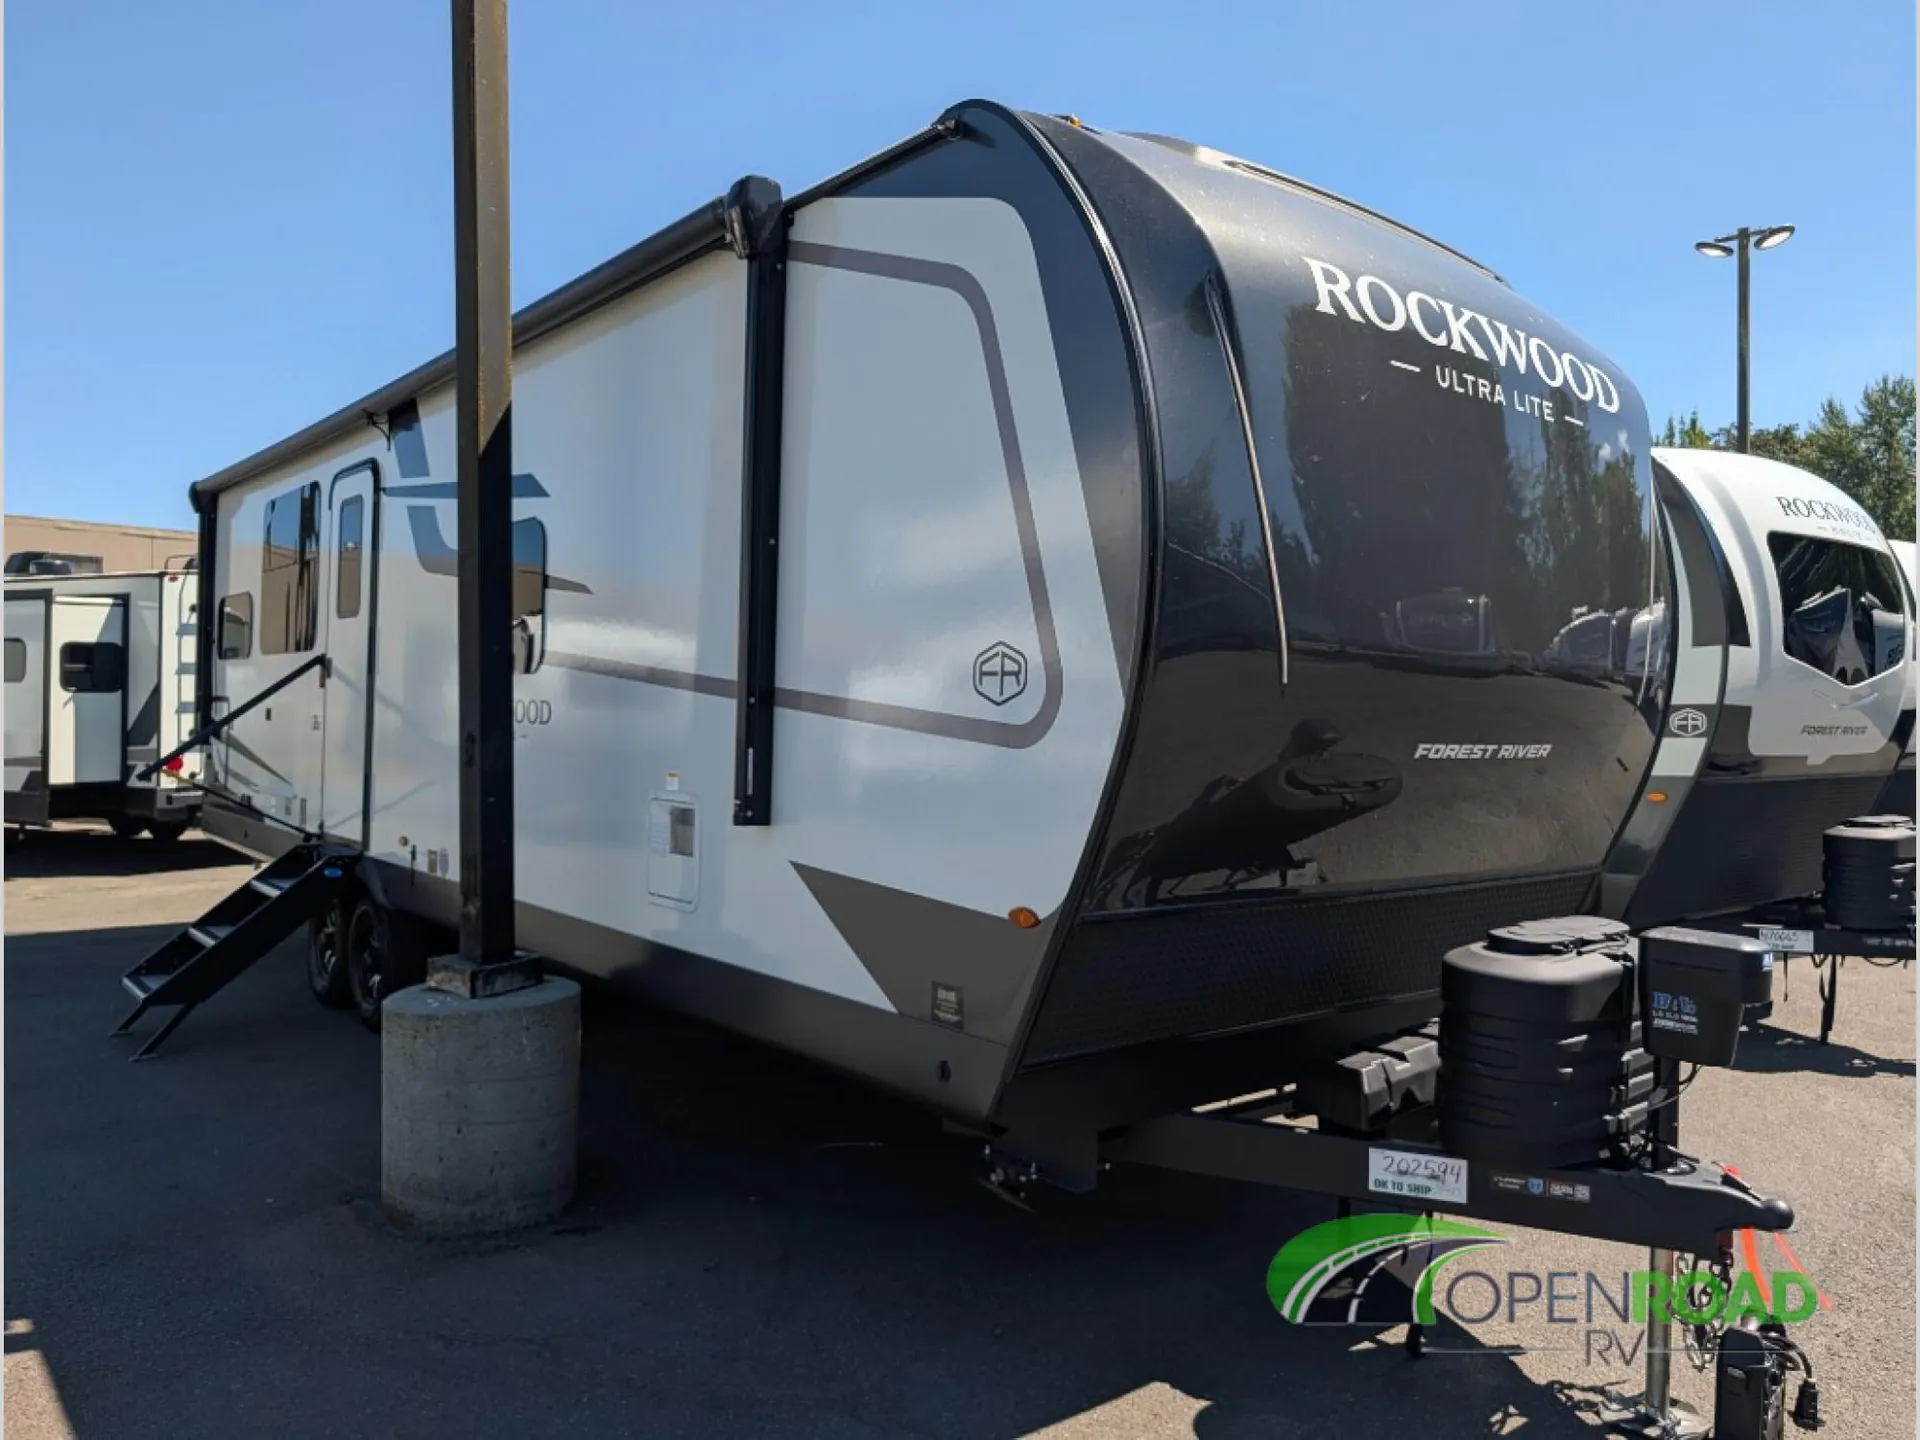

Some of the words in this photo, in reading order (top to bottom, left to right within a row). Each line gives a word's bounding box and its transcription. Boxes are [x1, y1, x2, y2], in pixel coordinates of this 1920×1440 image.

[1302, 256, 1620, 414] ROCKWOOD
[1435, 365, 1505, 406] ULTRA
[1514, 391, 1555, 421] LITE
[1413, 743, 1498, 759] FOREST
[1497, 744, 1553, 759] RIVER
[1383, 1155, 1462, 1185] 202594
[1374, 1178, 1389, 1189] OK
[1392, 1180, 1403, 1192] TO
[1407, 1183, 1432, 1195] SHIP
